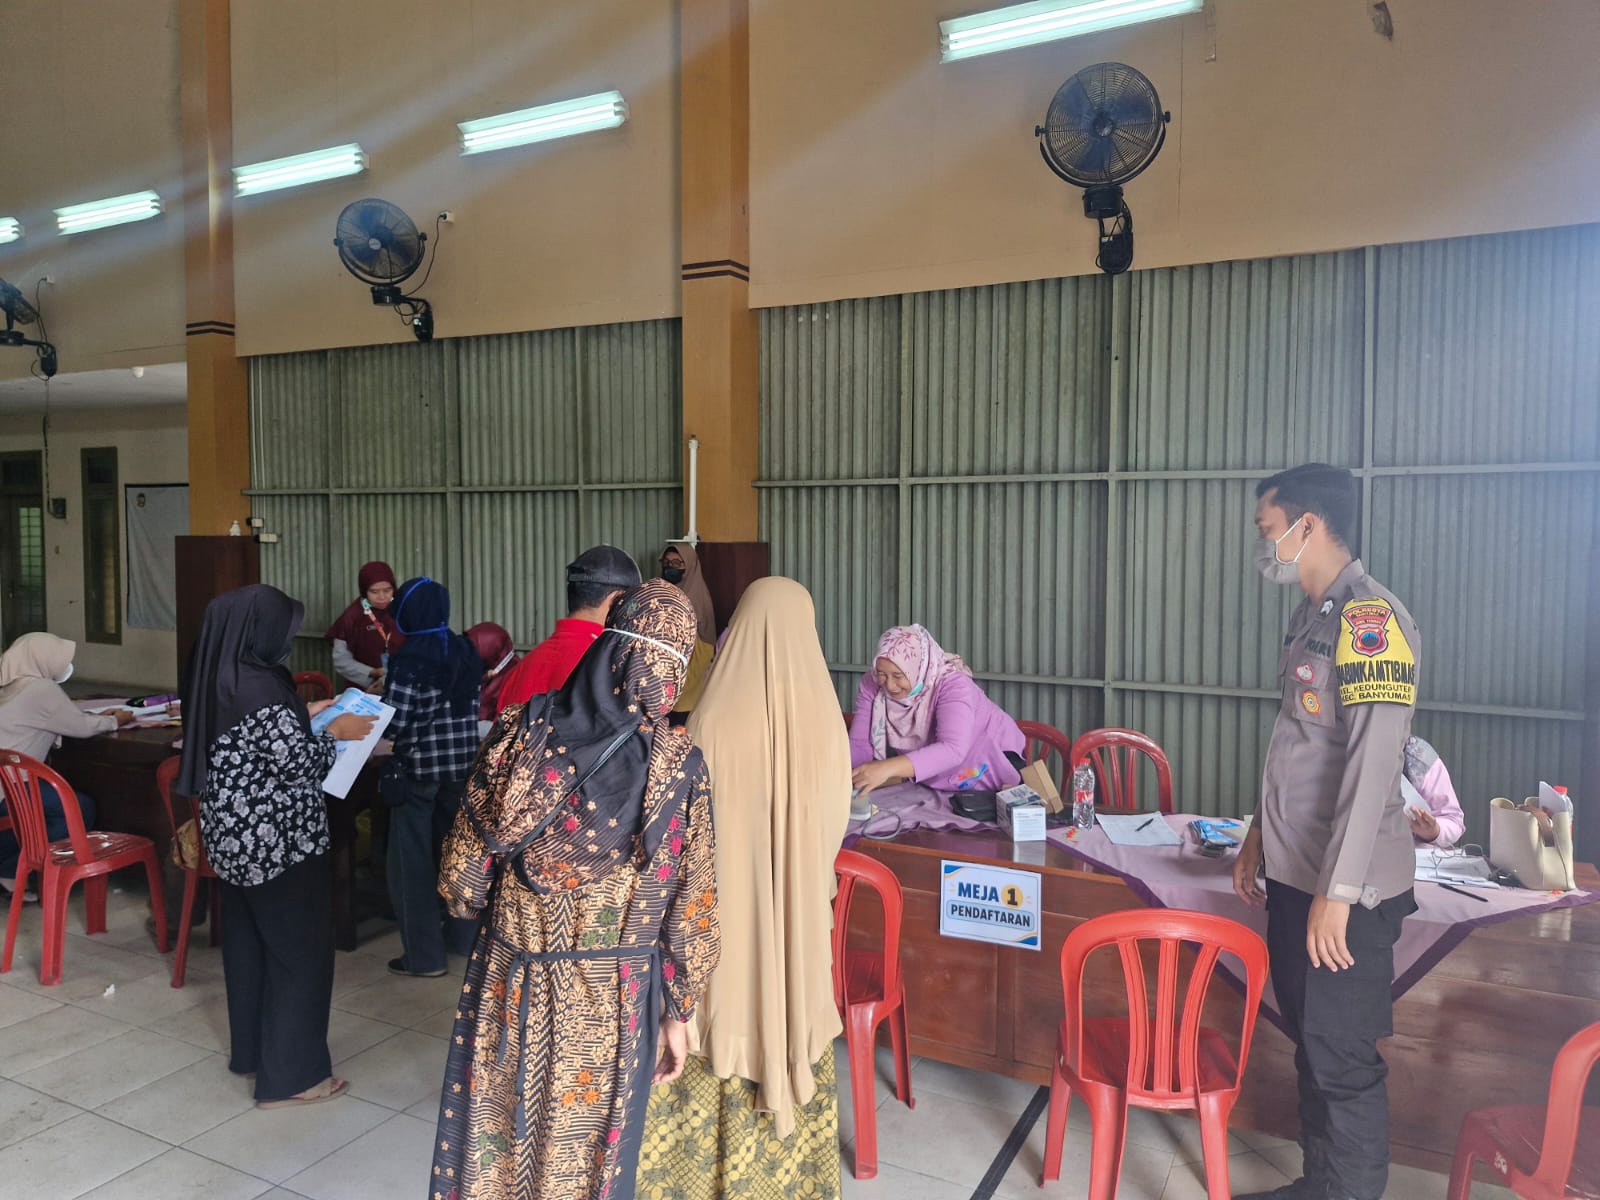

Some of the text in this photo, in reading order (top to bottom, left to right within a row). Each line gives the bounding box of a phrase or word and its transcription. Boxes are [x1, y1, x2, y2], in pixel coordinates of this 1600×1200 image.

[1359, 692, 1411, 701] BANYUMAS
[958, 882, 1018, 906] MEJA 1
[951, 904, 1030, 927] PENDAFTARAN
